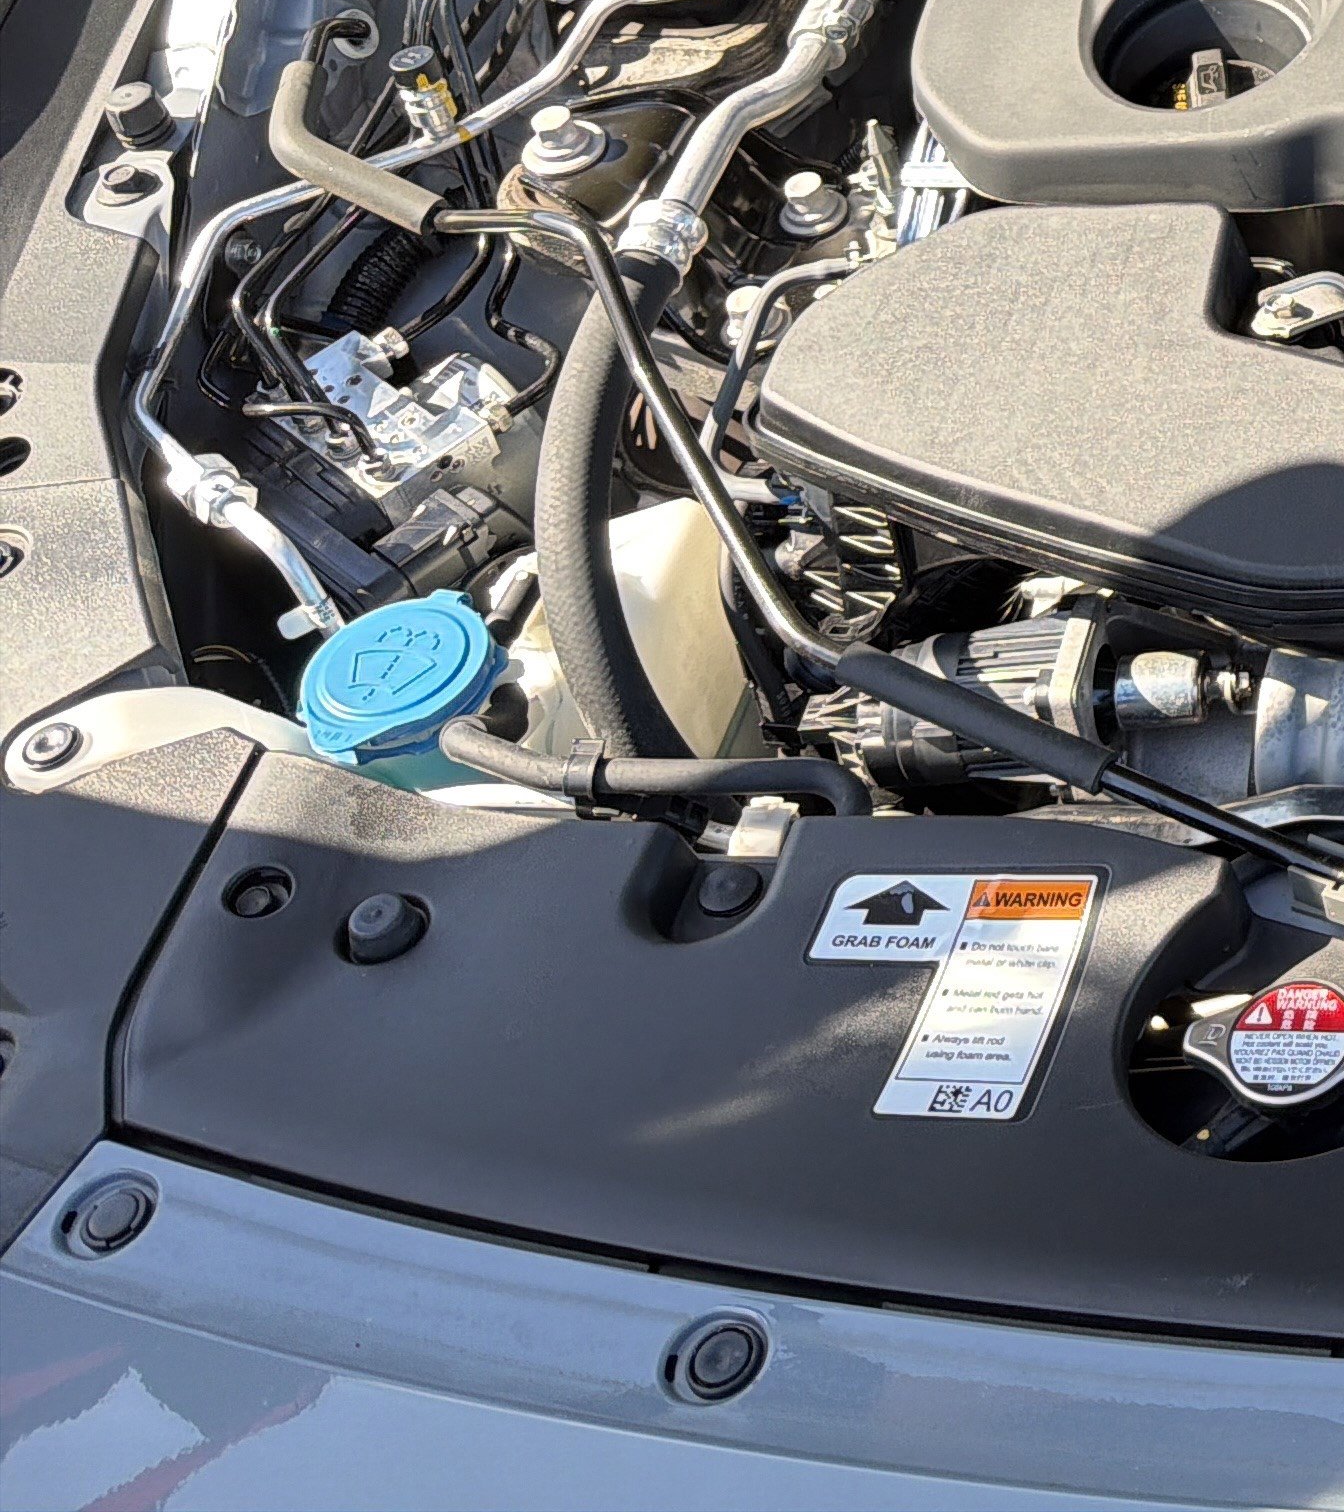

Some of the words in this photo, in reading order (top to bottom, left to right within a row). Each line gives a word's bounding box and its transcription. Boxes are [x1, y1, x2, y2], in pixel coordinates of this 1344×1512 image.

[994, 891, 1084, 908] WARNING
[831, 934, 883, 949] GRAB
[884, 935, 937, 950] FOAM
[971, 941, 987, 952] Do
[988, 942, 1006, 952] not
[1002, 990, 1025, 1002] gets
[1277, 988, 1329, 1000] DANGER
[933, 1033, 970, 1046] Always
[986, 1036, 1006, 1046] rod
[925, 1049, 955, 1061] using
[956, 1049, 984, 1061] foam
[969, 1089, 1015, 1113] A0
